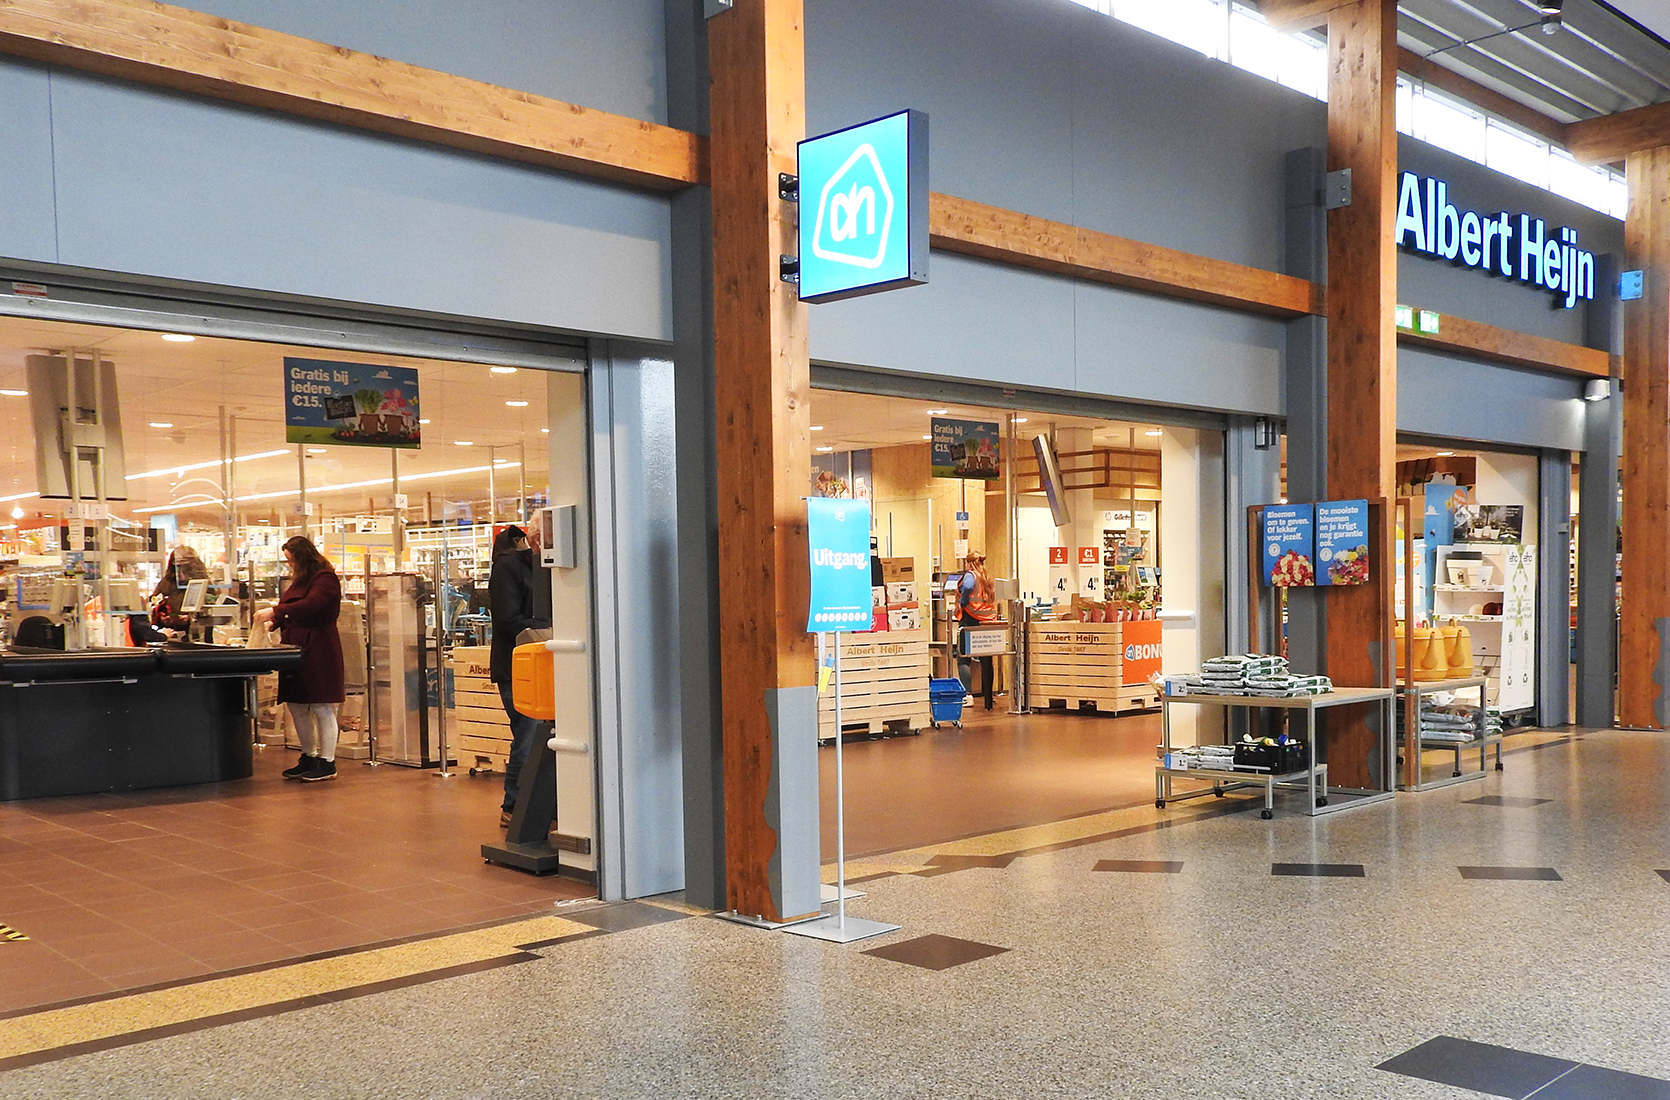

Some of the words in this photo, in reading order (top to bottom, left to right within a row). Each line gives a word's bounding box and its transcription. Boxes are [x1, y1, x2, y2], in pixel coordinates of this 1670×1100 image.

[1395, 171, 1512, 276] Albert
[1520, 213, 1594, 309] Heijn
[290, 367, 330, 381] Gratis
[333, 370, 349, 385] bij
[291, 380, 332, 395] iedere
[291, 395, 322, 408] €15.
[934, 424, 953, 434] Gratis
[954, 426, 963, 436] bij
[934, 434, 954, 443] iedere
[934, 443, 949, 452] €15.
[1330, 507, 1359, 515] mooiste
[1287, 518, 1309, 526] geven.
[1329, 524, 1337, 532] je
[1337, 522, 1357, 531] krijgt
[1282, 533, 1303, 542] jezelf.
[1333, 530, 1364, 540] garantie
[1056, 548, 1062, 558] 2
[813, 548, 868, 570] Uitgang.
[1045, 634, 1072, 642] Albert
[1075, 634, 1100, 643] Heijn
[846, 646, 876, 655] Albert
[880, 644, 904, 655] Heijn
[469, 664, 491, 674] Alber
